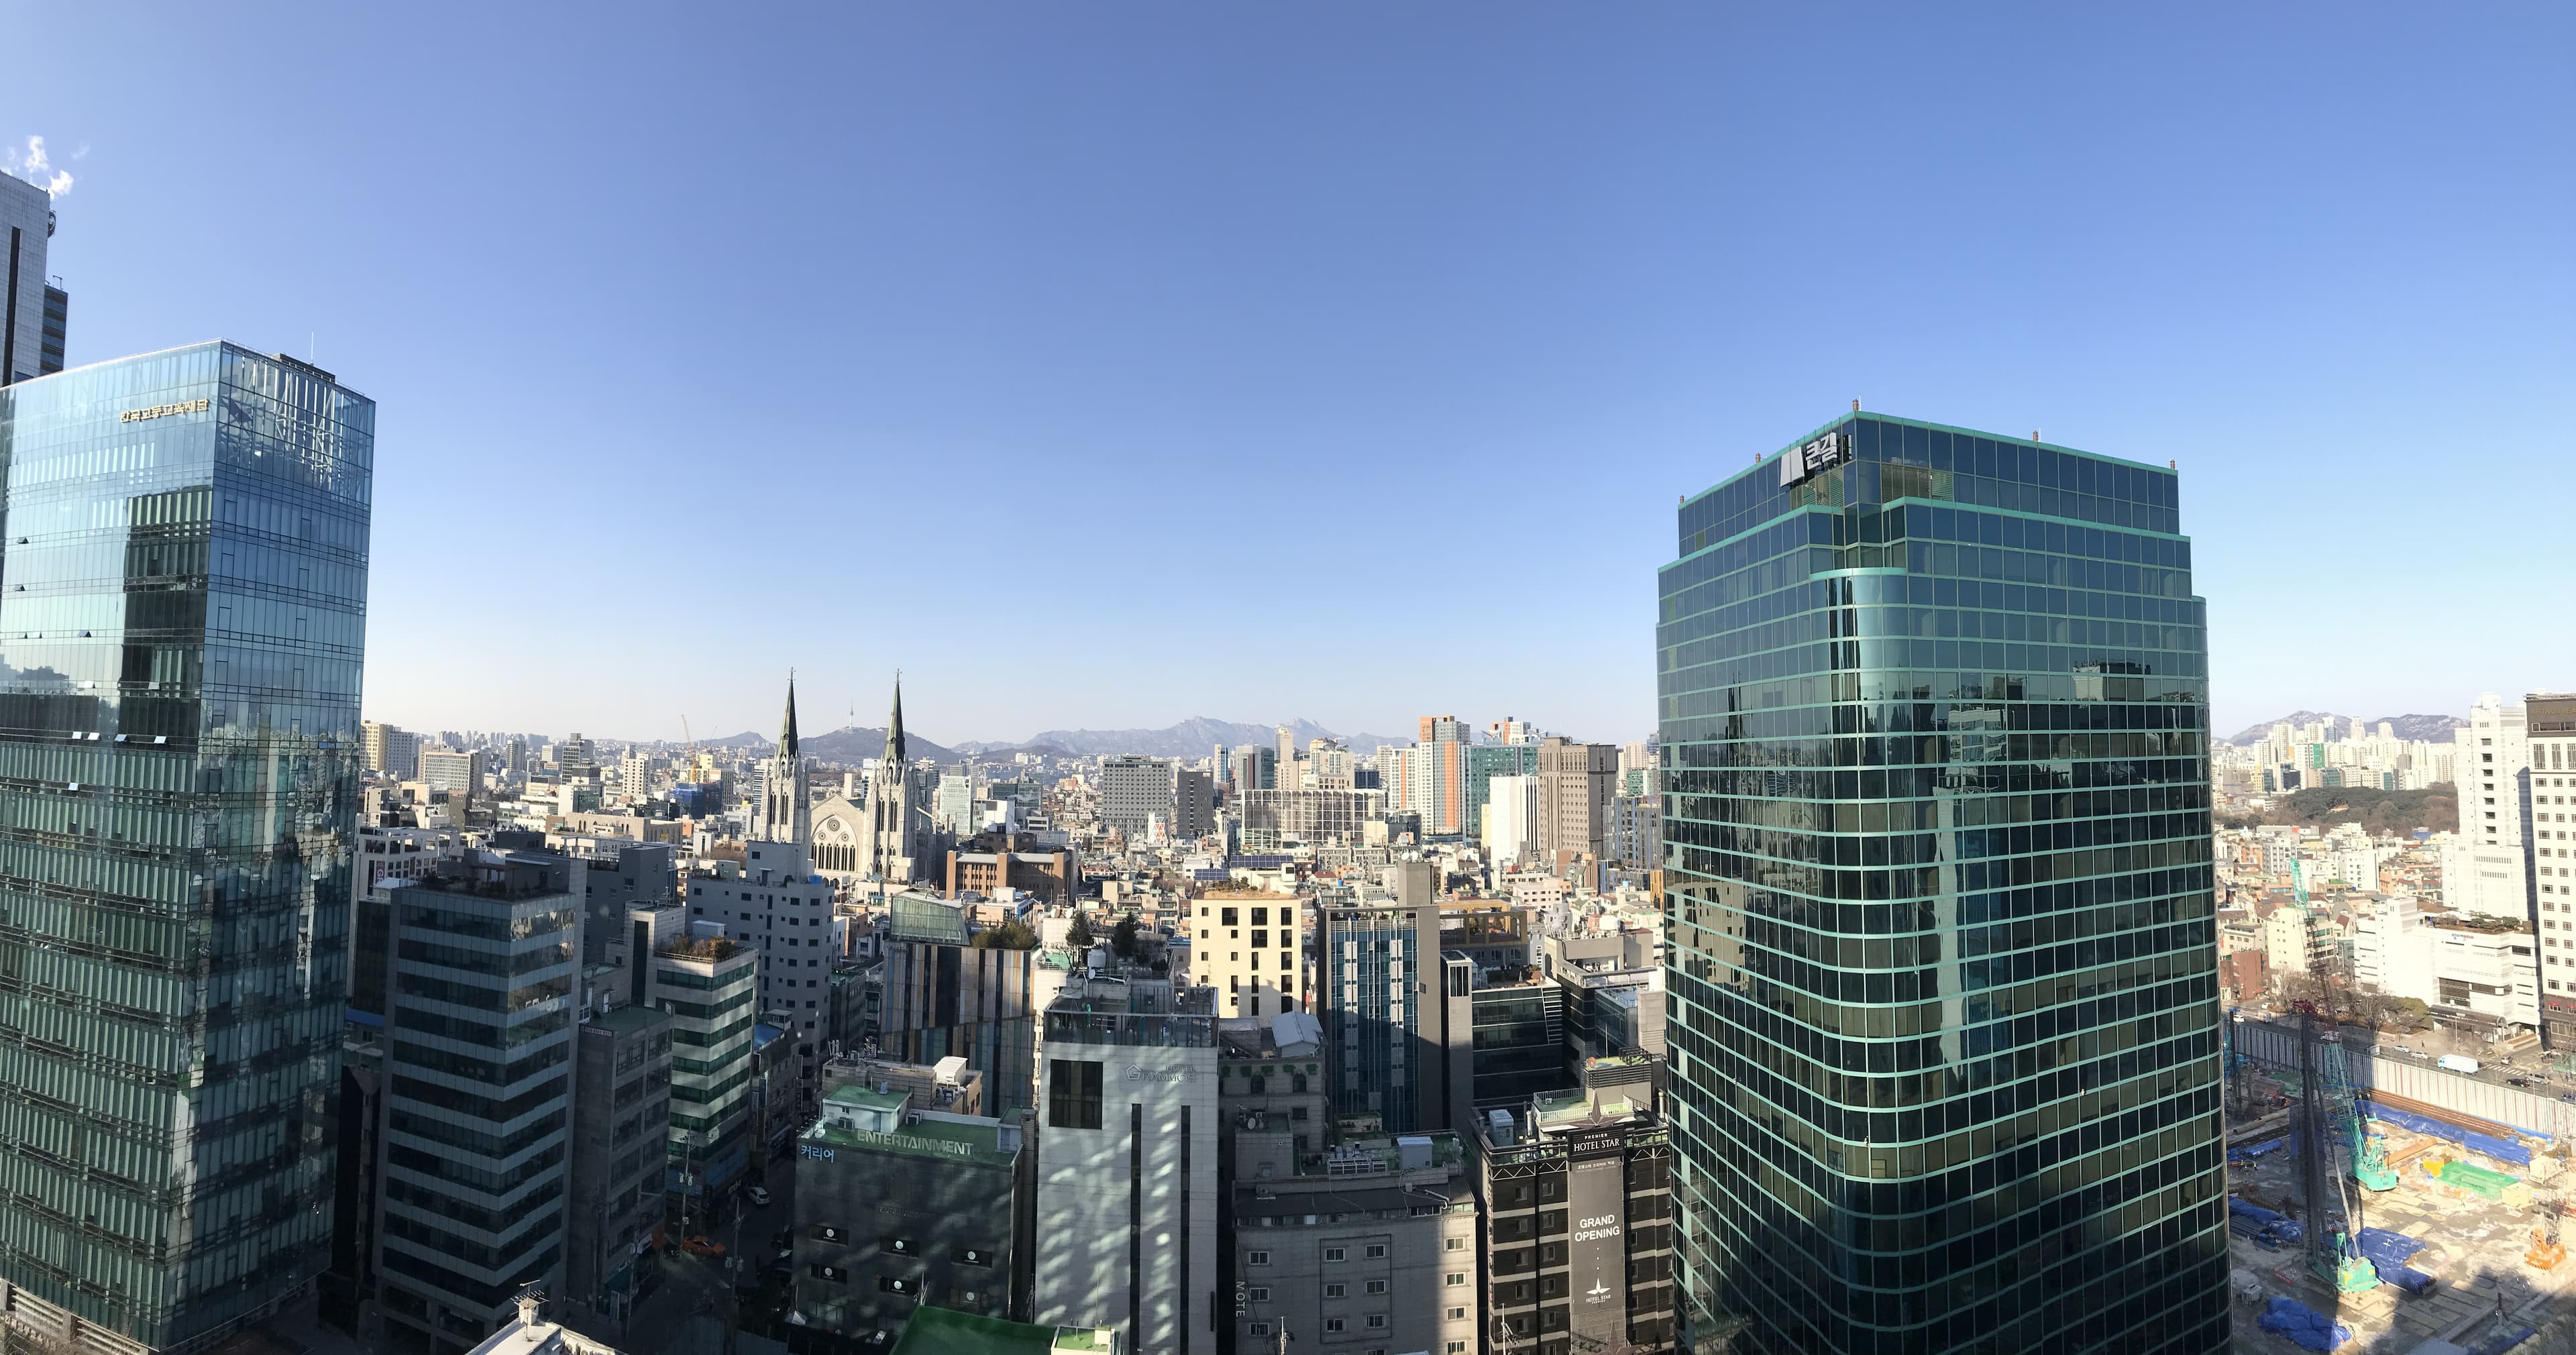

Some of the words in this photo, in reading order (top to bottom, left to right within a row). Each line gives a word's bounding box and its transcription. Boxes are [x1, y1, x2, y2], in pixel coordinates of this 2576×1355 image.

[857, 1129, 973, 1155] ENTERTAINMENT
[1574, 1141, 1599, 1152] HOTEL
[1601, 1138, 1620, 1148] STAR
[800, 1145, 834, 1163] 커리어
[1580, 1214, 1615, 1228] GRAND
[1574, 1226, 1620, 1242] OPENING
